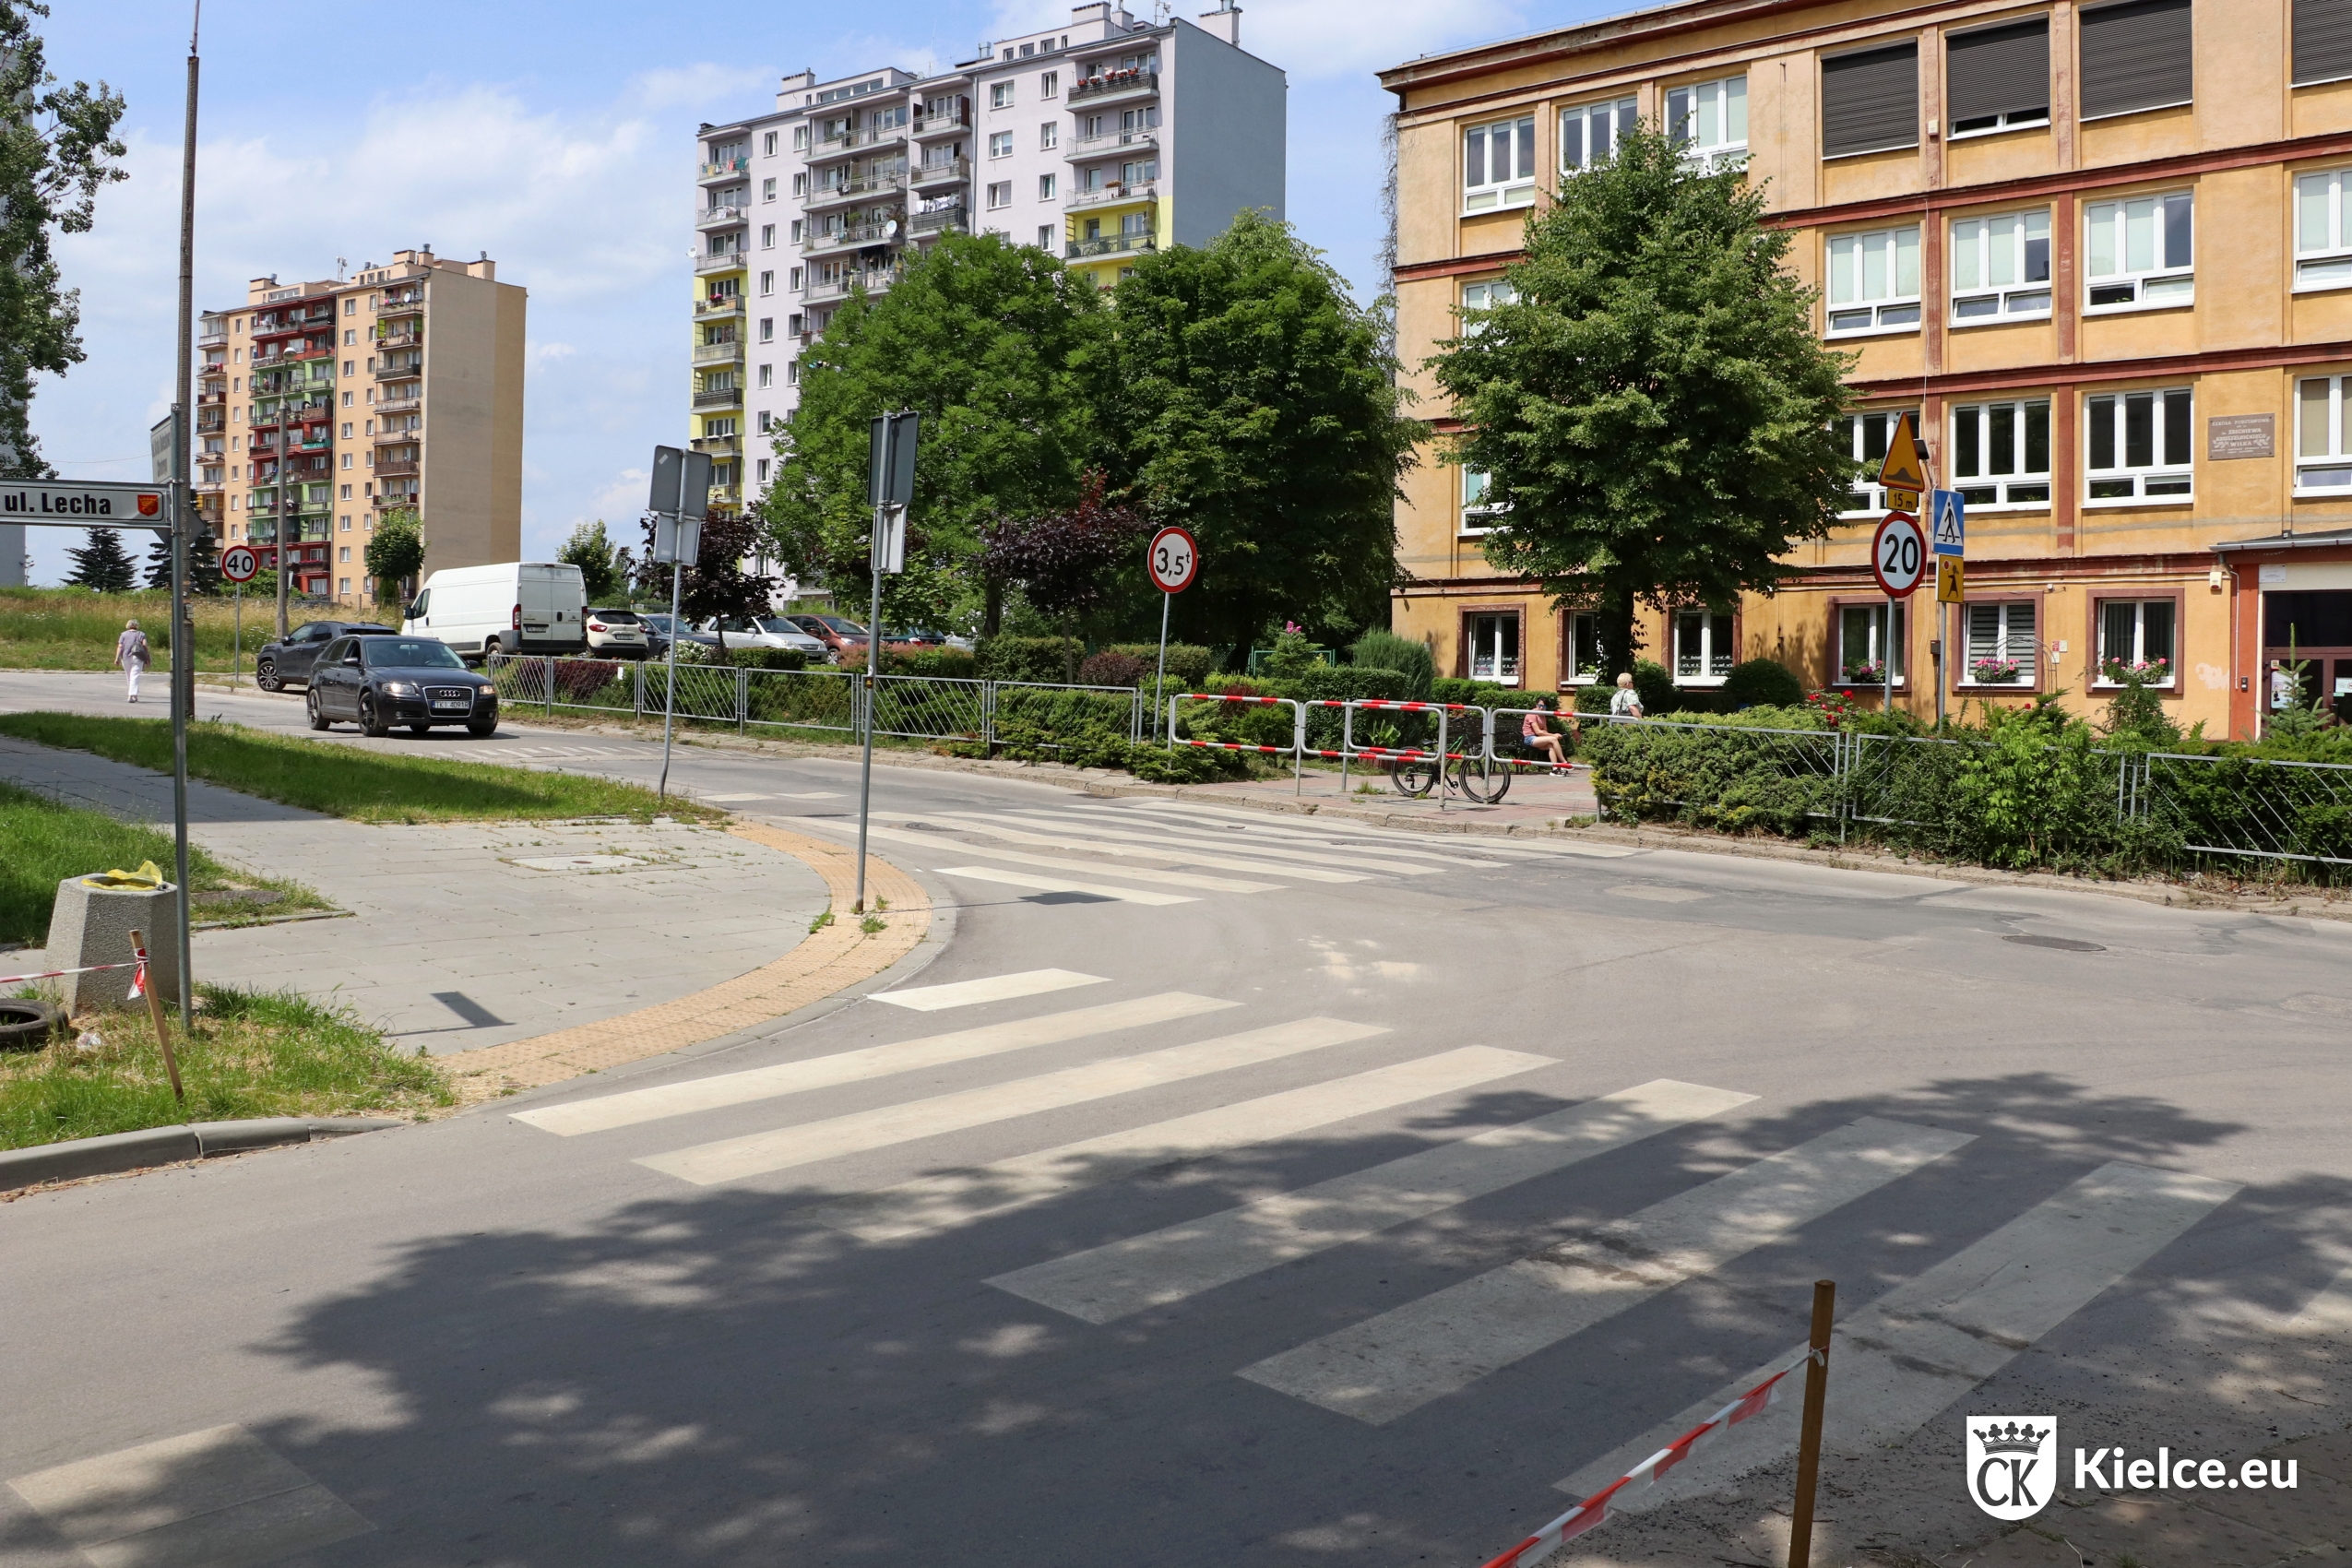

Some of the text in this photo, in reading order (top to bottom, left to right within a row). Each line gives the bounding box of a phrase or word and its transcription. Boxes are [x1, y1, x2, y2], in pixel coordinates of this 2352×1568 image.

[5, 492, 112, 515] ul. Lecha
[1894, 493, 1903, 507] 15
[227, 554, 254, 573] 40
[1883, 533, 1918, 576] 20
